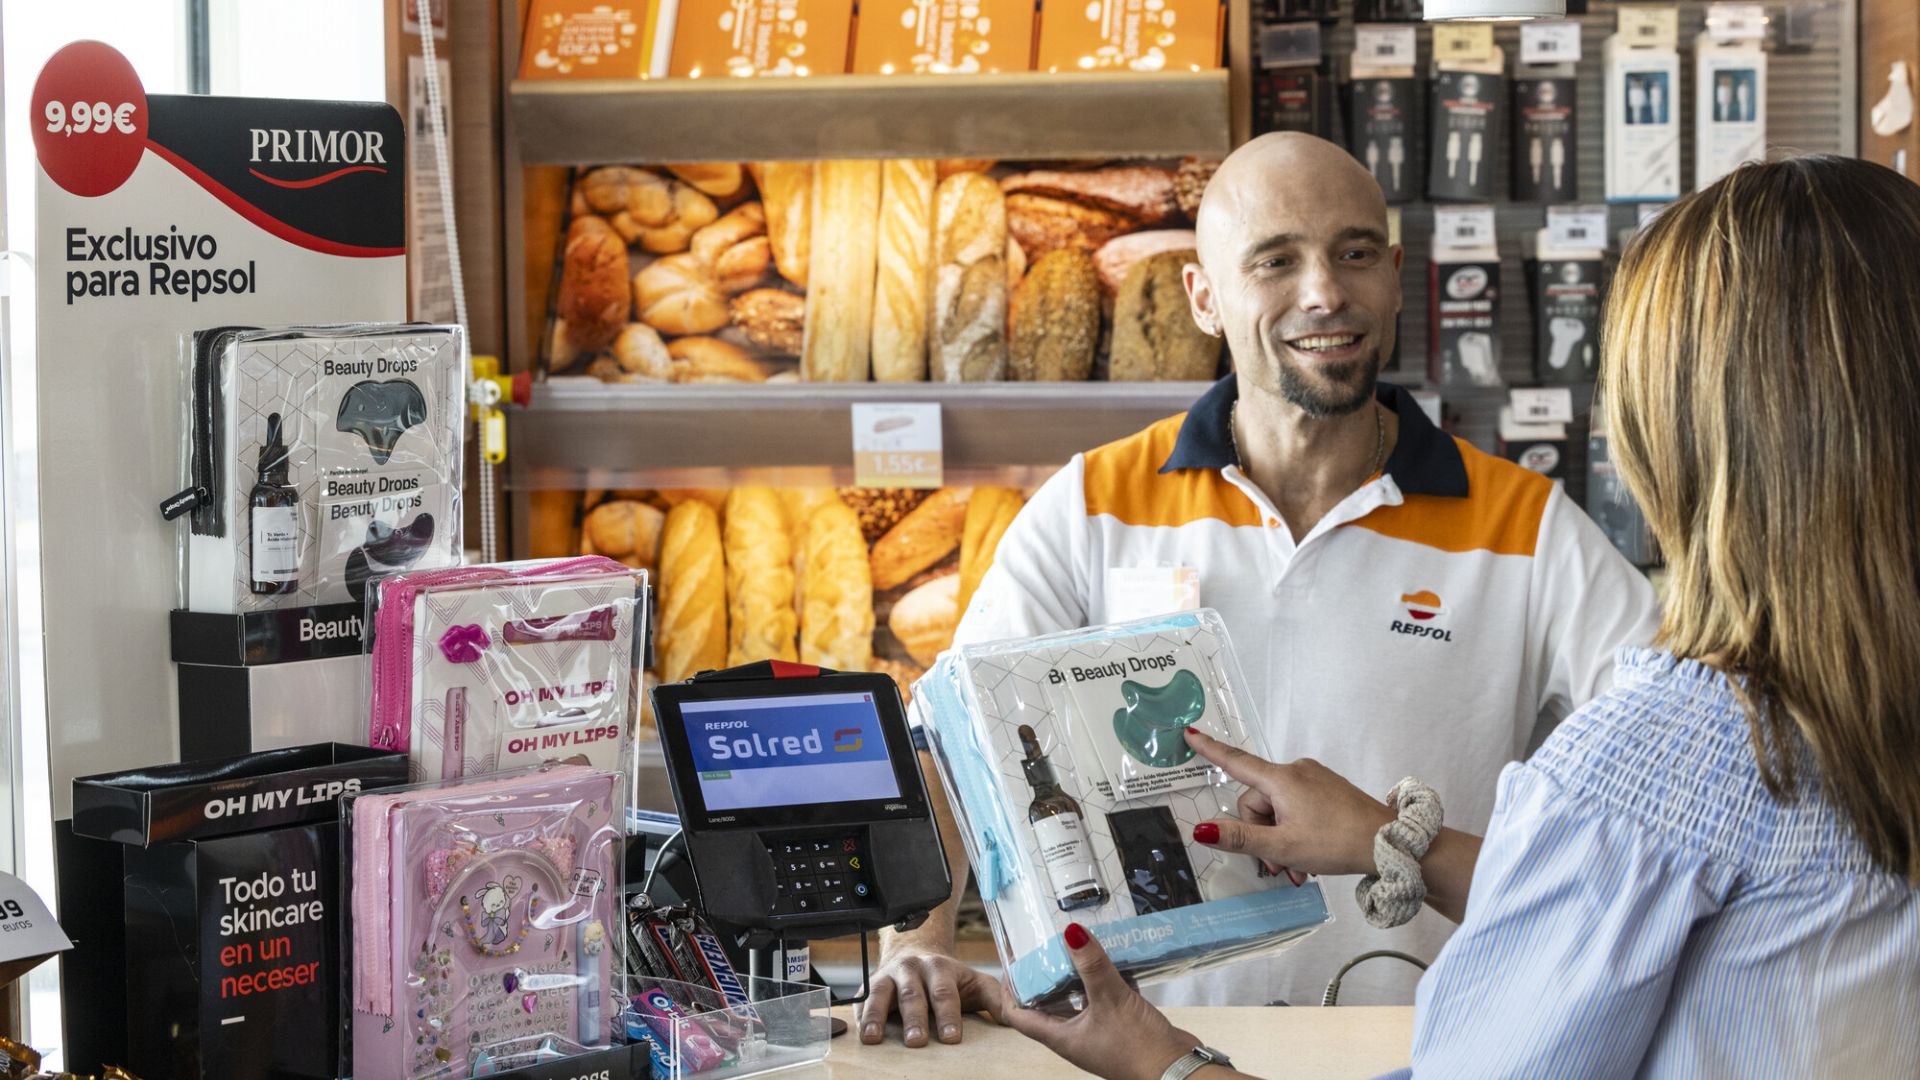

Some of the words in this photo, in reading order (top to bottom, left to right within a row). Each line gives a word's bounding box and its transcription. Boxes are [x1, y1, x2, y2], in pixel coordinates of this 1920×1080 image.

[45, 100, 137, 137] 9,99€
[249, 129, 387, 164] PRIMOR
[66, 225, 217, 261] Exclusivo
[66, 264, 139, 304] para
[150, 260, 256, 302] Repsol
[324, 359, 373, 378] Beauty
[377, 357, 417, 376] Drops
[328, 479, 376, 497] Beauty
[379, 476, 418, 493] Drops
[331, 500, 378, 521] Beauty
[382, 494, 422, 513] Drops
[300, 615, 366, 642] Beauty
[1390, 619, 1452, 642] REPSOL
[1071, 661, 1127, 683] Beauty
[1128, 653, 1177, 673] Drops
[504, 688, 535, 706] OH
[538, 685, 566, 702] MY
[570, 679, 615, 699] LIPS
[508, 736, 538, 754] OH
[541, 731, 571, 750] MY
[573, 725, 619, 745] LIPS
[704, 720, 750, 731] REPSOL
[708, 728, 823, 760] Solred
[204, 795, 248, 820] OH
[252, 788, 295, 814] MY
[296, 778, 362, 806] LIPS
[785, 845, 792, 853] 2
[814, 843, 820, 851] 3
[790, 863, 797, 871] 5
[819, 861, 826, 869] 6
[219, 872, 285, 904] Todo
[291, 869, 317, 894] tu
[2, 919, 33, 932] euros
[219, 899, 324, 936] skincare
[1101, 929, 1130, 949] auty
[1132, 922, 1174, 944] Drops
[220, 943, 253, 968] en
[260, 936, 291, 959] un
[221, 960, 320, 998] neceser
[788, 963, 807, 976] pay
